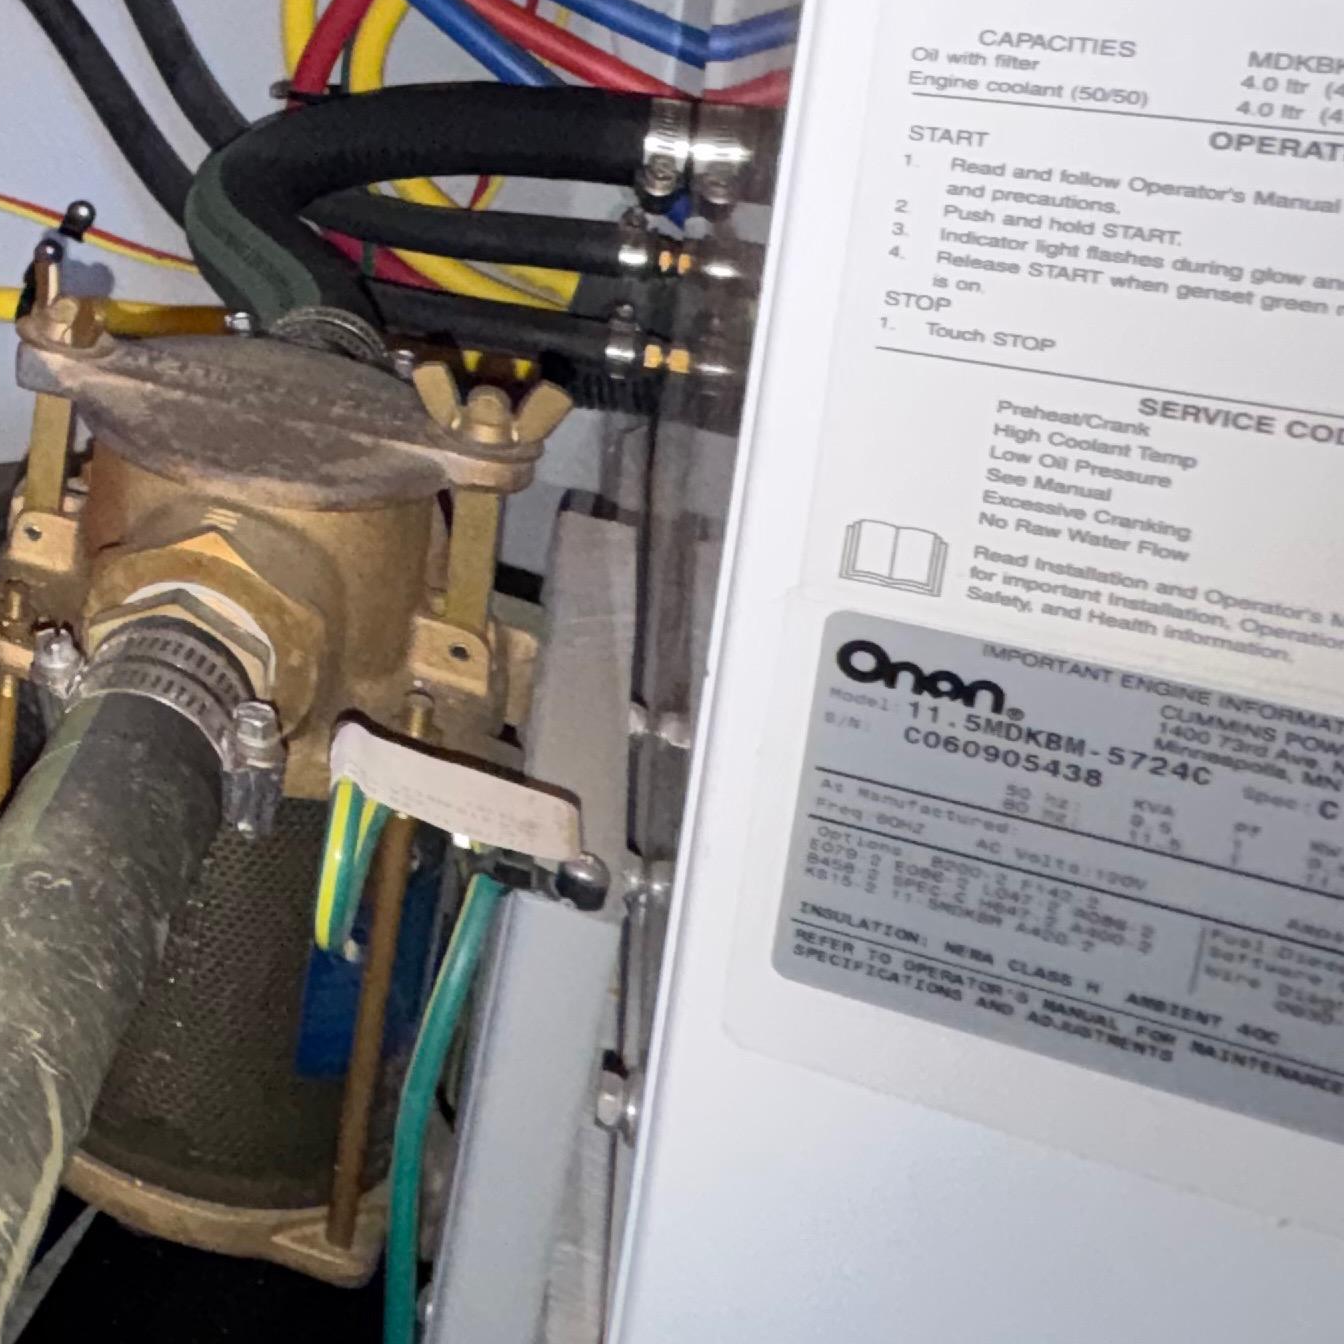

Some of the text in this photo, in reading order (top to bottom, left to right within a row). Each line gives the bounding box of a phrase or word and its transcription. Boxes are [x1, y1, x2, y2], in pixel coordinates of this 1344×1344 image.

[911, 46, 1040, 72] Oil with filter
[978, 28, 1137, 58] CAPACITIES
[908, 70, 1149, 108] Engine coolant (50/50)
[908, 124, 989, 149] START
[946, 182, 1122, 216] and precautions.
[951, 156, 1342, 216] Read and follow Manual
[943, 205, 1095, 237] Push and hold
[939, 228, 1307, 288] Indicator light flashes during glow
[884, 290, 951, 313] STOP
[933, 275, 948, 290] is
[937, 250, 1328, 317] Release START when green
[927, 322, 1056, 353] Touch STOP
[997, 398, 1151, 438] Preheat/Crank
[1137, 397, 1277, 437] SERVICE
[993, 421, 1199, 471] High Coolant Temp
[986, 467, 1112, 503] See Manual
[989, 445, 1173, 489] Low Oil Pressure
[982, 489, 1193, 543] Excessive Cranking
[979, 510, 1190, 563] No Raw Water Flow
[969, 565, 1102, 606] for important
[973, 544, 1198, 602] Read and
[1041, 598, 1158, 637] and Health
[982, 643, 1114, 684] IMPORTANT
[1121, 672, 1212, 706] ENGINE
[1161, 705, 1278, 743] CUMMINS
